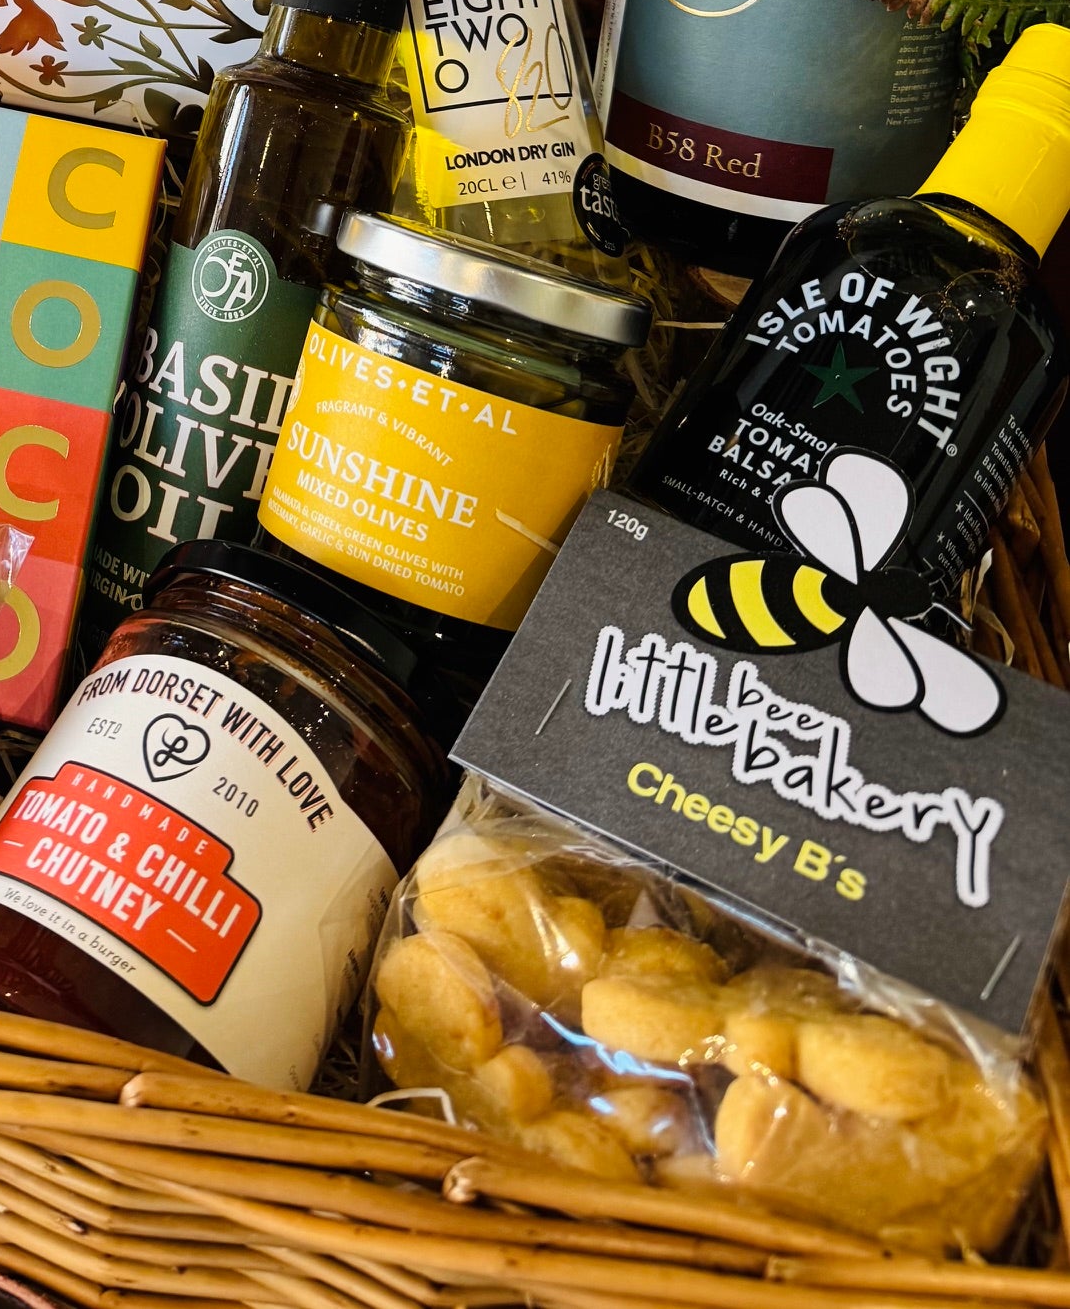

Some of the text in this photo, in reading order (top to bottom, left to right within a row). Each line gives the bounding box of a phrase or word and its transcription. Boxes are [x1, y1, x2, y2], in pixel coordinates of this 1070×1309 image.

[425, 12, 529, 57] TWO
[445, 142, 576, 171] LONDON DRY GIN
[458, 170, 572, 196] 20CL 41%
[646, 121, 762, 179] B58 Red
[745, 271, 895, 347] ISLE OF
[775, 309, 917, 419] TOMATOES
[315, 400, 454, 467] FRAGRANT VIBRANT
[286, 421, 479, 530] SUNSHINE
[297, 469, 429, 542] MIXED OLIVES
[662, 475, 736, 518] SMALL-BATCH
[300, 521, 465, 597] GARLIC DRIED TOMATO
[311, 507, 464, 581] GREEK GREEN OLIVES WITH
[606, 507, 649, 543] 120g
[131, 667, 335, 833] DORSET WITH LOVE
[592, 631, 993, 895] little bee bakery
[71, 772, 210, 856] HANDMADE
[211, 775, 261, 819] 2010
[626, 761, 790, 865] Cheesy
[12, 789, 242, 939] TOMATO CHILLI
[26, 837, 165, 933] CHUTNEY
[88, 928, 137, 976] burger
